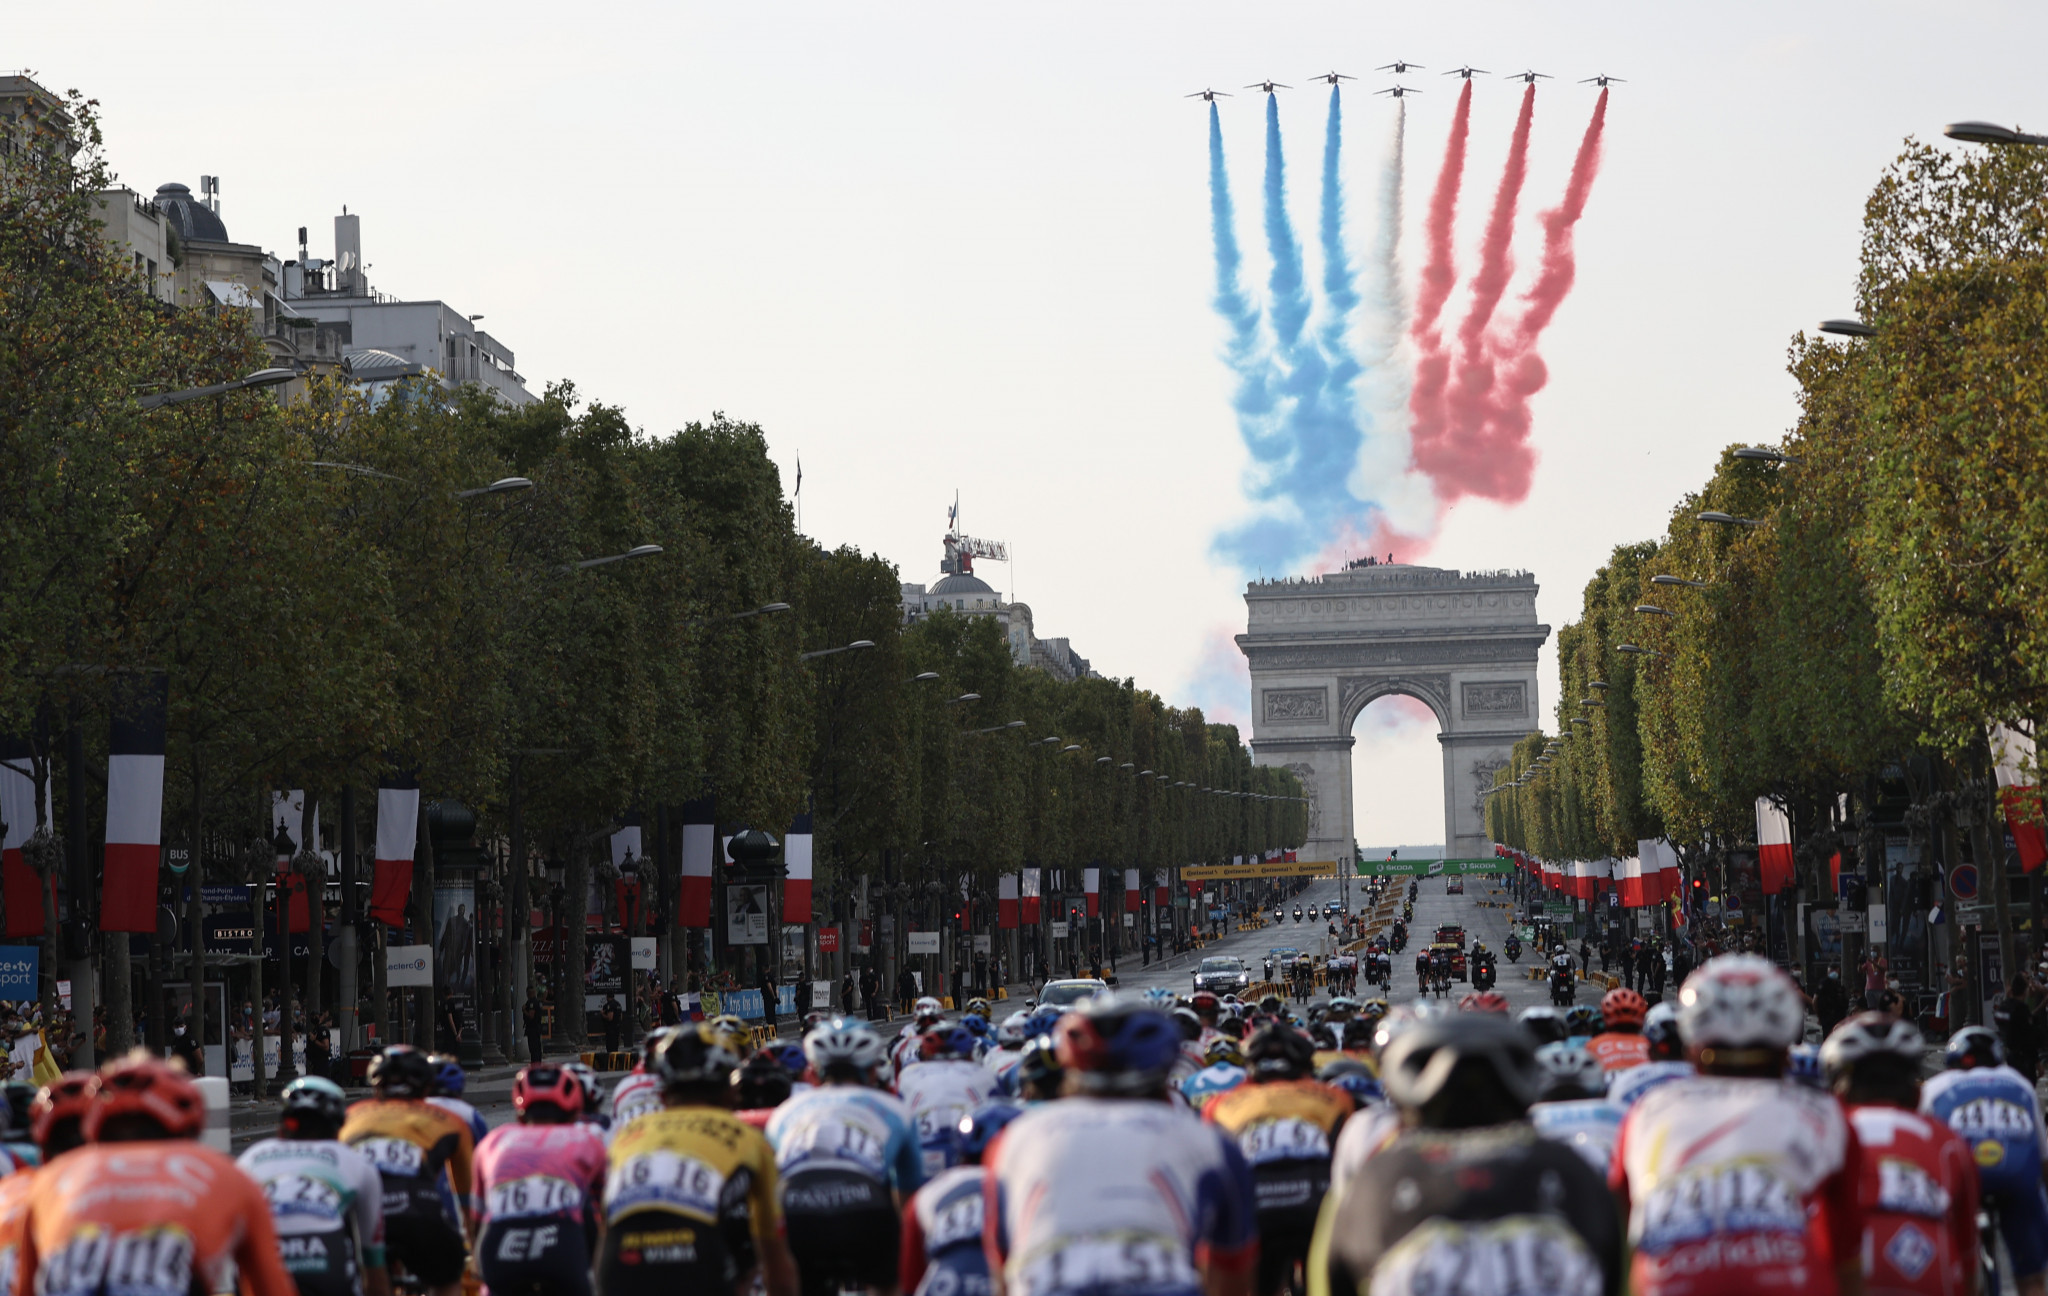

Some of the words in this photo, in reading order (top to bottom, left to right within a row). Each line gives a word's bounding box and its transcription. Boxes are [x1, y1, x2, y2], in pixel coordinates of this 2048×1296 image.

[170, 849, 188, 859] BUS
[0, 973, 30, 987] port
[677, 1161, 709, 1196] 16
[500, 1181, 528, 1211] 76
[497, 1224, 559, 1262] EF
